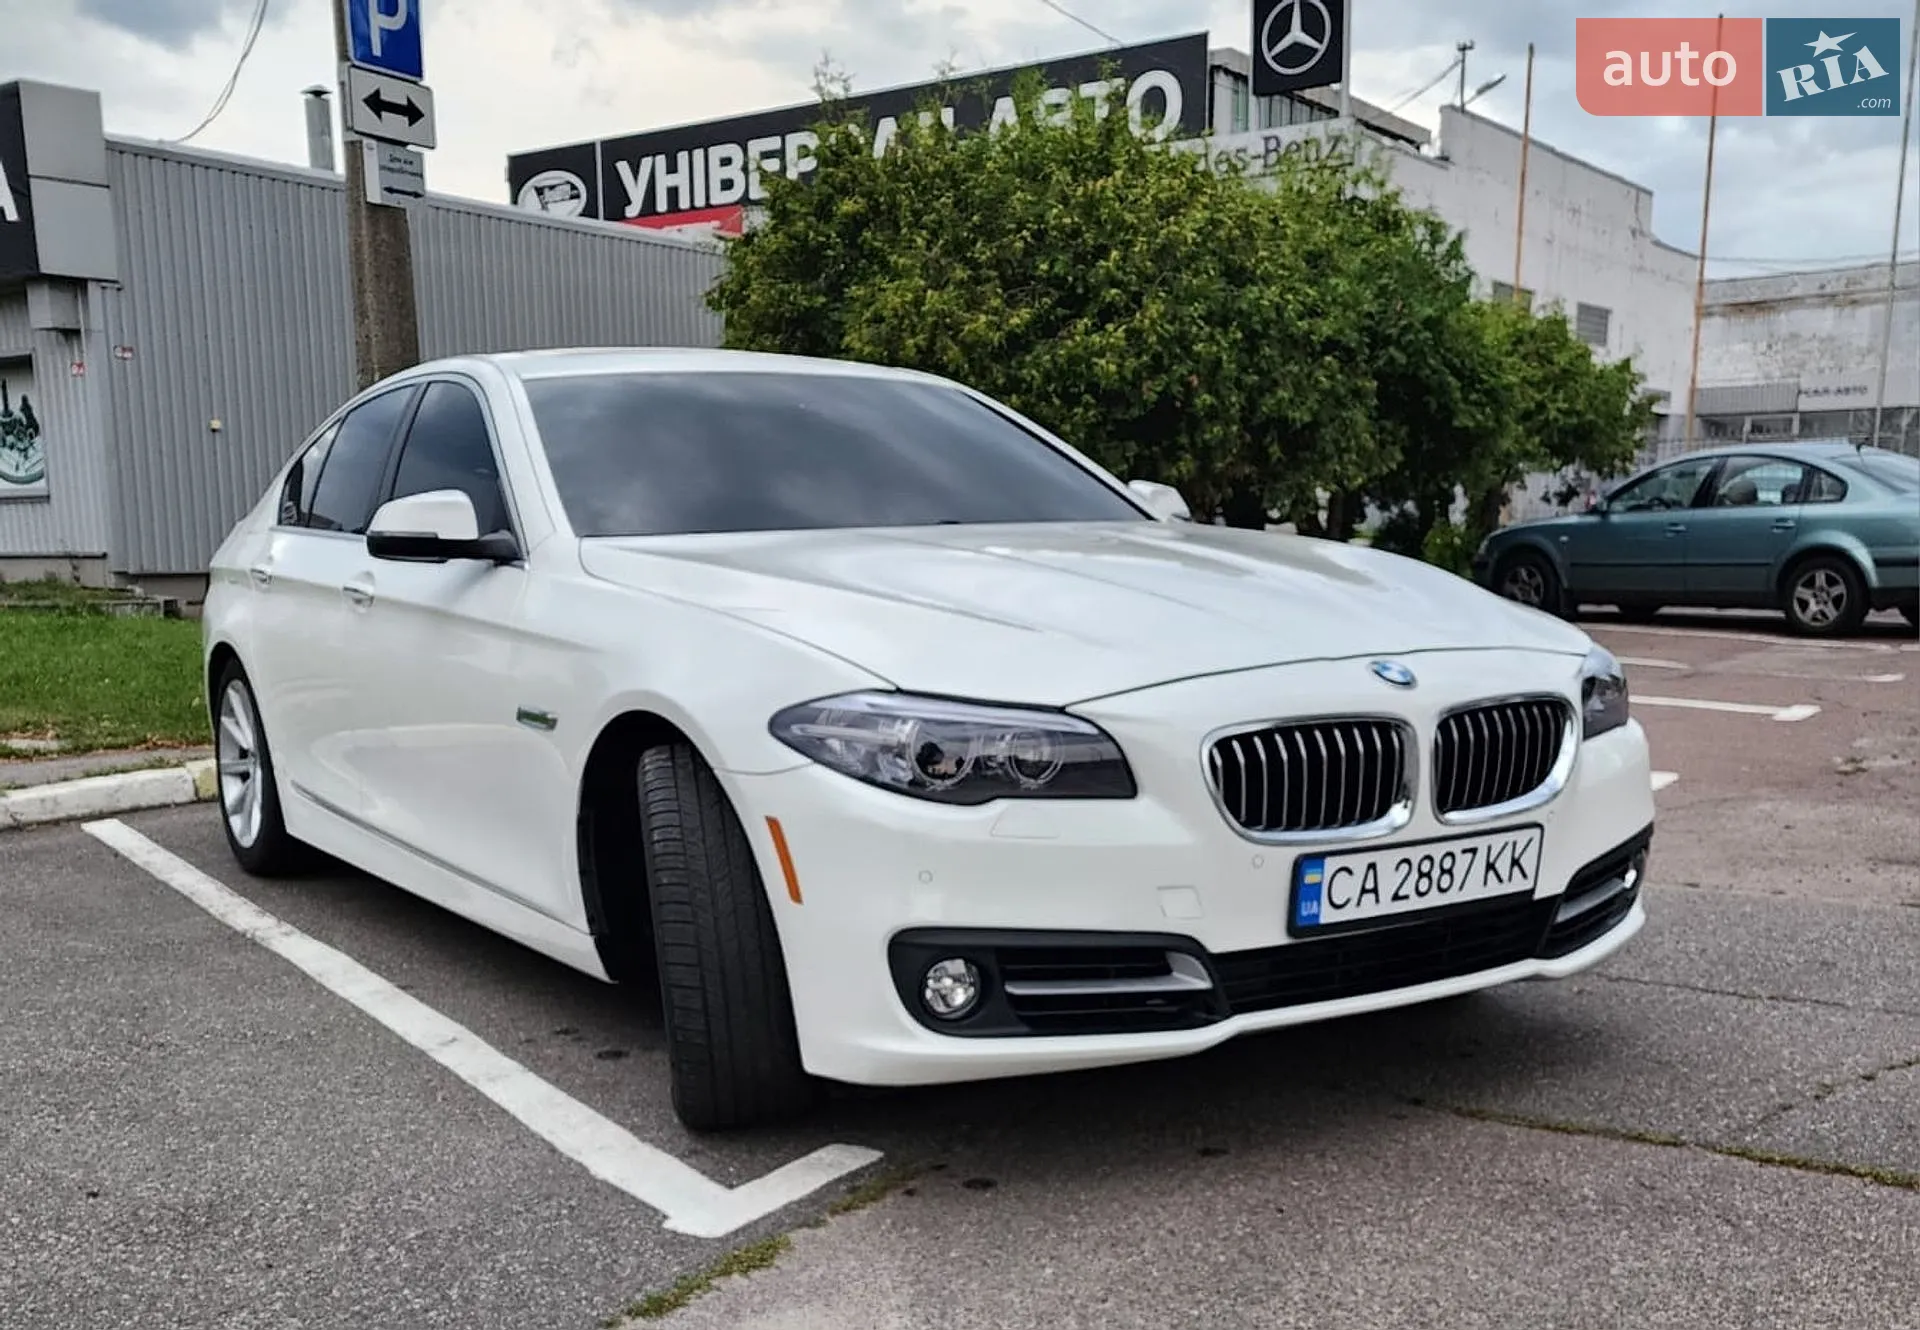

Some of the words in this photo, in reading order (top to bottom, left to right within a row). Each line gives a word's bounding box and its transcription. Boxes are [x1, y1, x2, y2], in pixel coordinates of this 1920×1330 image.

[368, 0, 407, 57] P
[1327, 861, 1380, 910] CA
[1391, 846, 1479, 902] 2887
[1483, 836, 1534, 887] KK
[1301, 900, 1319, 917] UA
